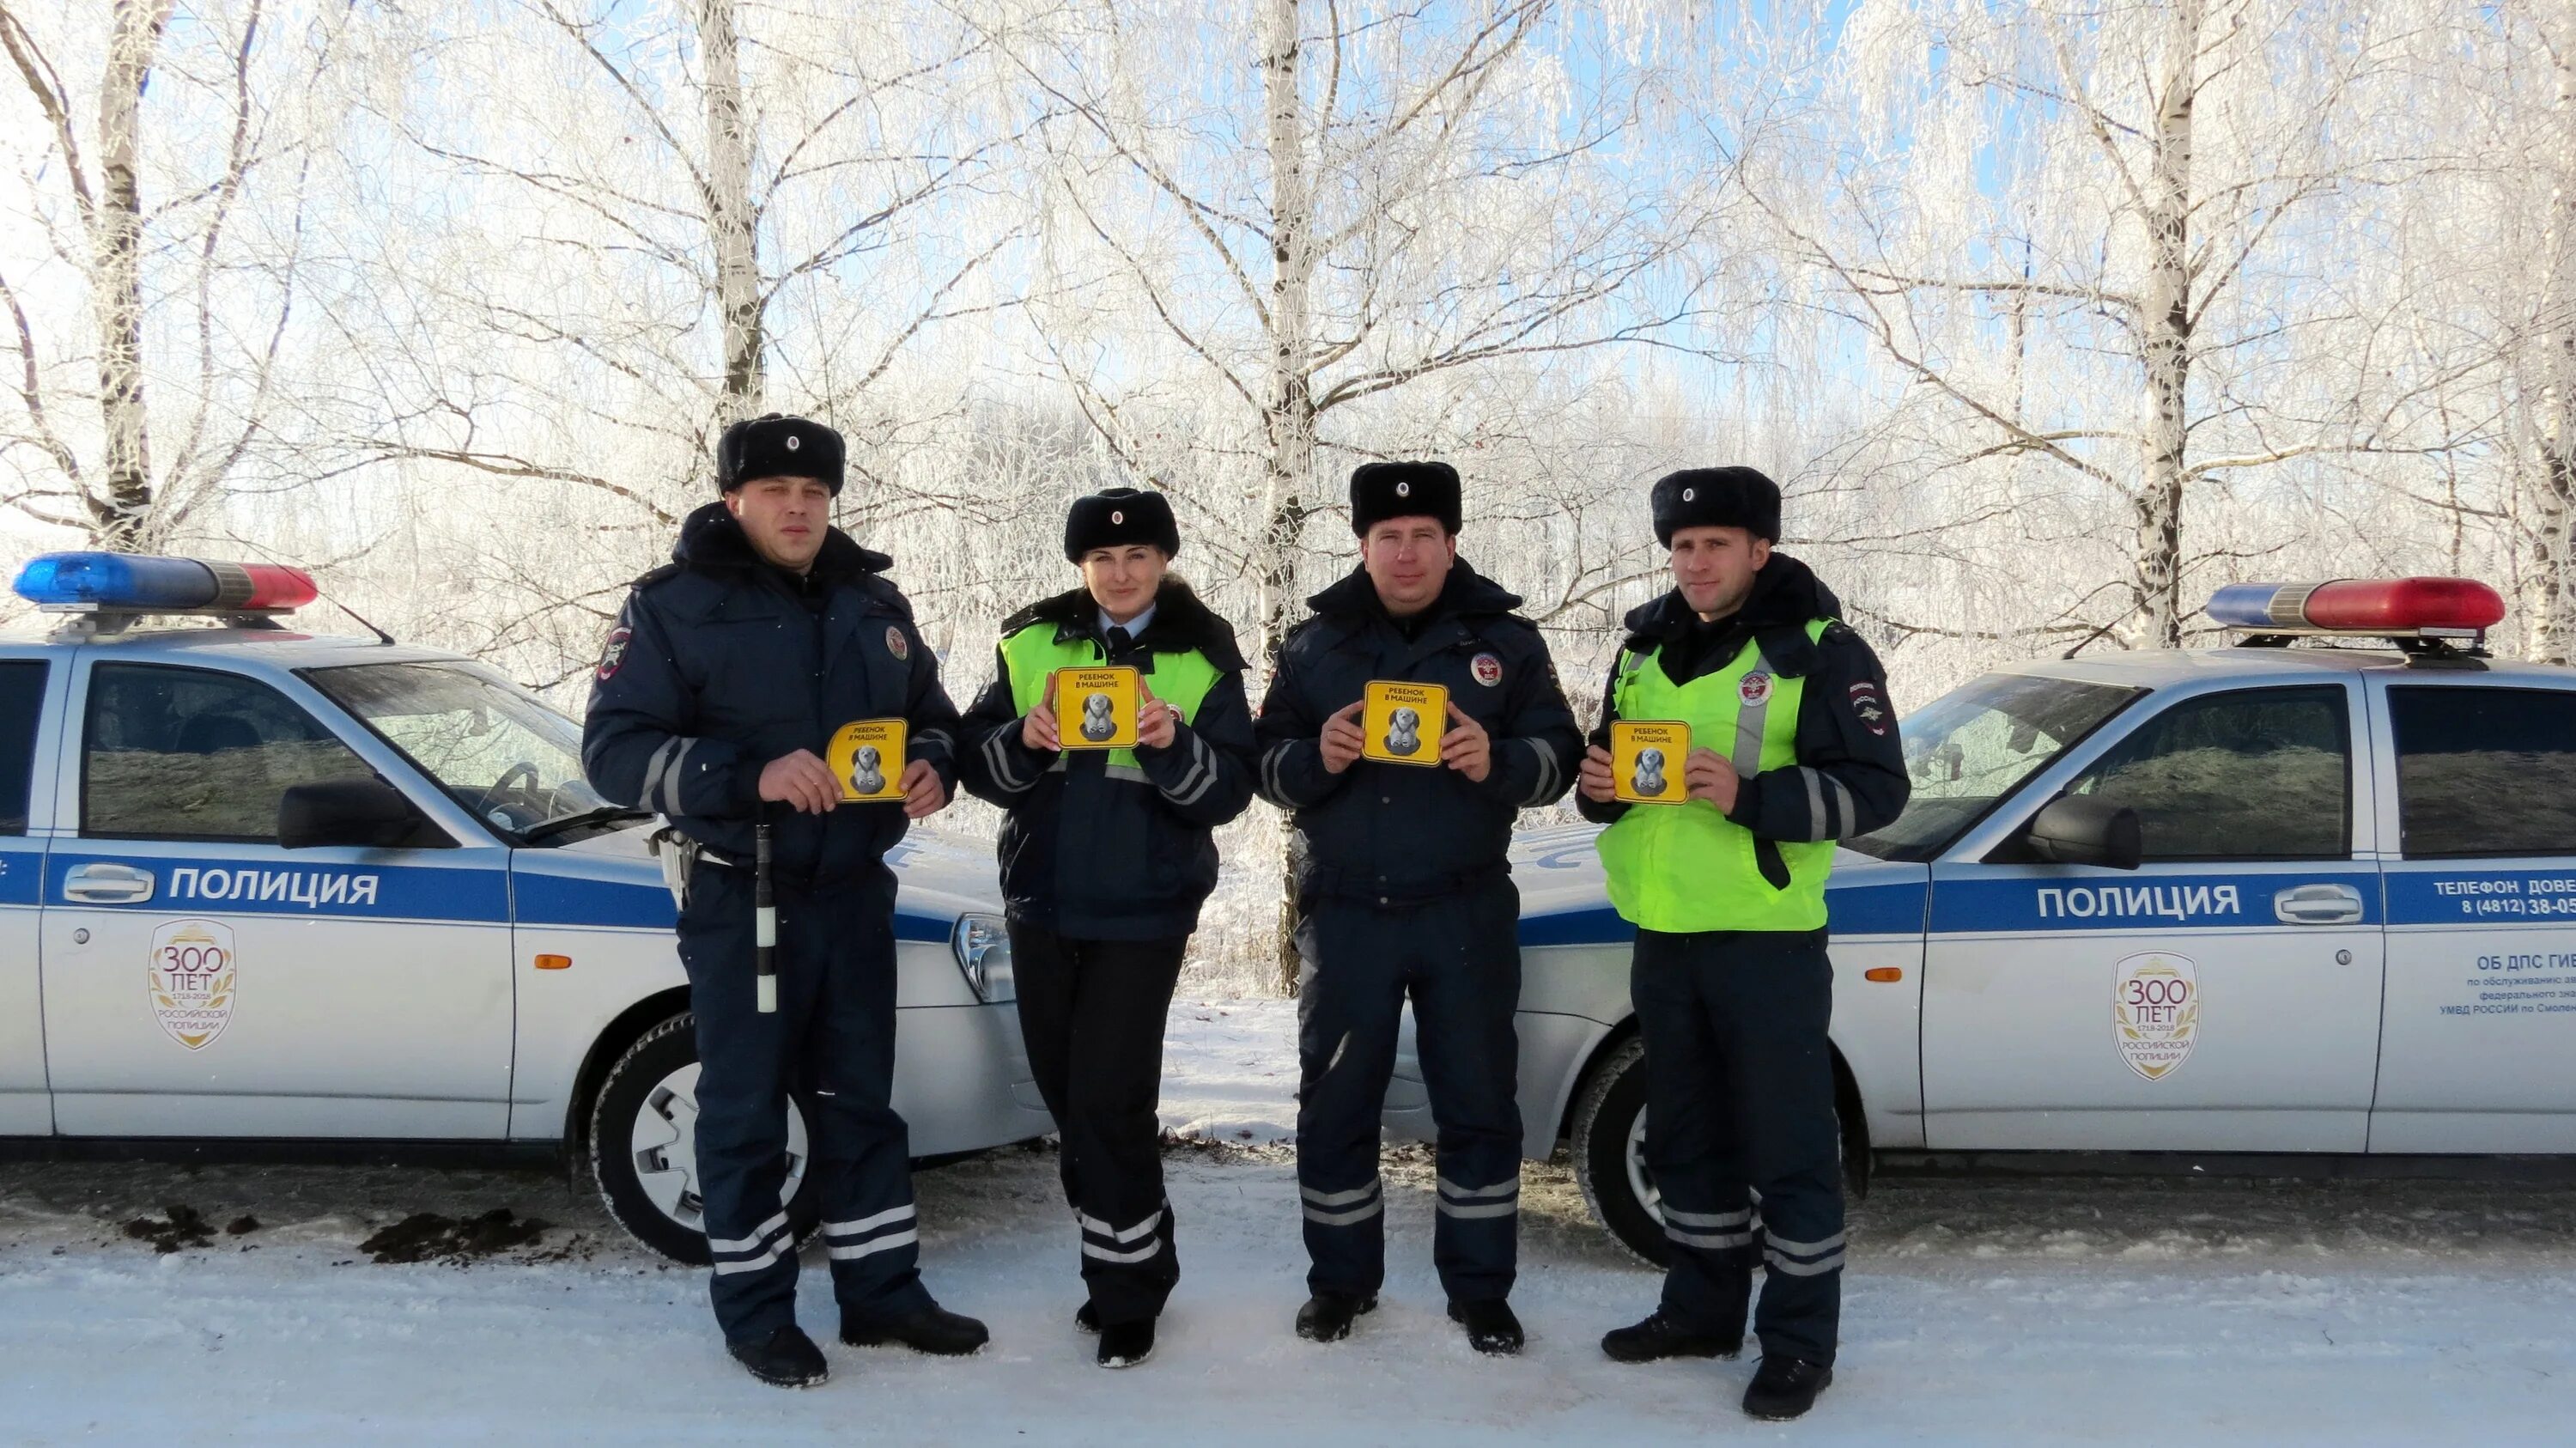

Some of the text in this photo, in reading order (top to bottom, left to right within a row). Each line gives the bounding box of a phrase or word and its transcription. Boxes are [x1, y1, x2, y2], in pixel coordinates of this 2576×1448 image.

[1388, 687, 1425, 696] РЕБЕНОК
[1391, 695, 1427, 704] МАШИНЕ
[1636, 735, 1673, 744] МАШИНЕ
[169, 867, 380, 909] ПОЛИЦИЯ
[2433, 880, 2520, 896] ТЕЛЕФОН
[2037, 885, 2240, 922] ПОЛИЦИЯ
[2462, 900, 2472, 914] 8
[2476, 898, 2526, 916] (4812)
[162, 946, 224, 973] 300
[2477, 955, 2502, 970] ОБ
[2506, 954, 2543, 972] ДПС
[172, 973, 214, 992] ЛЕТ
[2467, 977, 2481, 986] по
[2482, 976, 2561, 988] обслуживанию
[2128, 979, 2187, 1005] 300
[2479, 990, 2556, 1002] федерального
[158, 1009, 228, 1019] РОССИЙСКОЙ
[2136, 1006, 2177, 1025] ЛЕТ
[2439, 1005, 2470, 1016] УМВД
[2473, 1003, 2518, 1014] РОССИИ
[2521, 1005, 2534, 1013] по
[167, 1021, 220, 1030] ПОЛИЦИИ
[2122, 1040, 2190, 1050] РОССИЙСКОЙ
[2130, 1052, 2181, 1061] ПОЛИЦИИ
